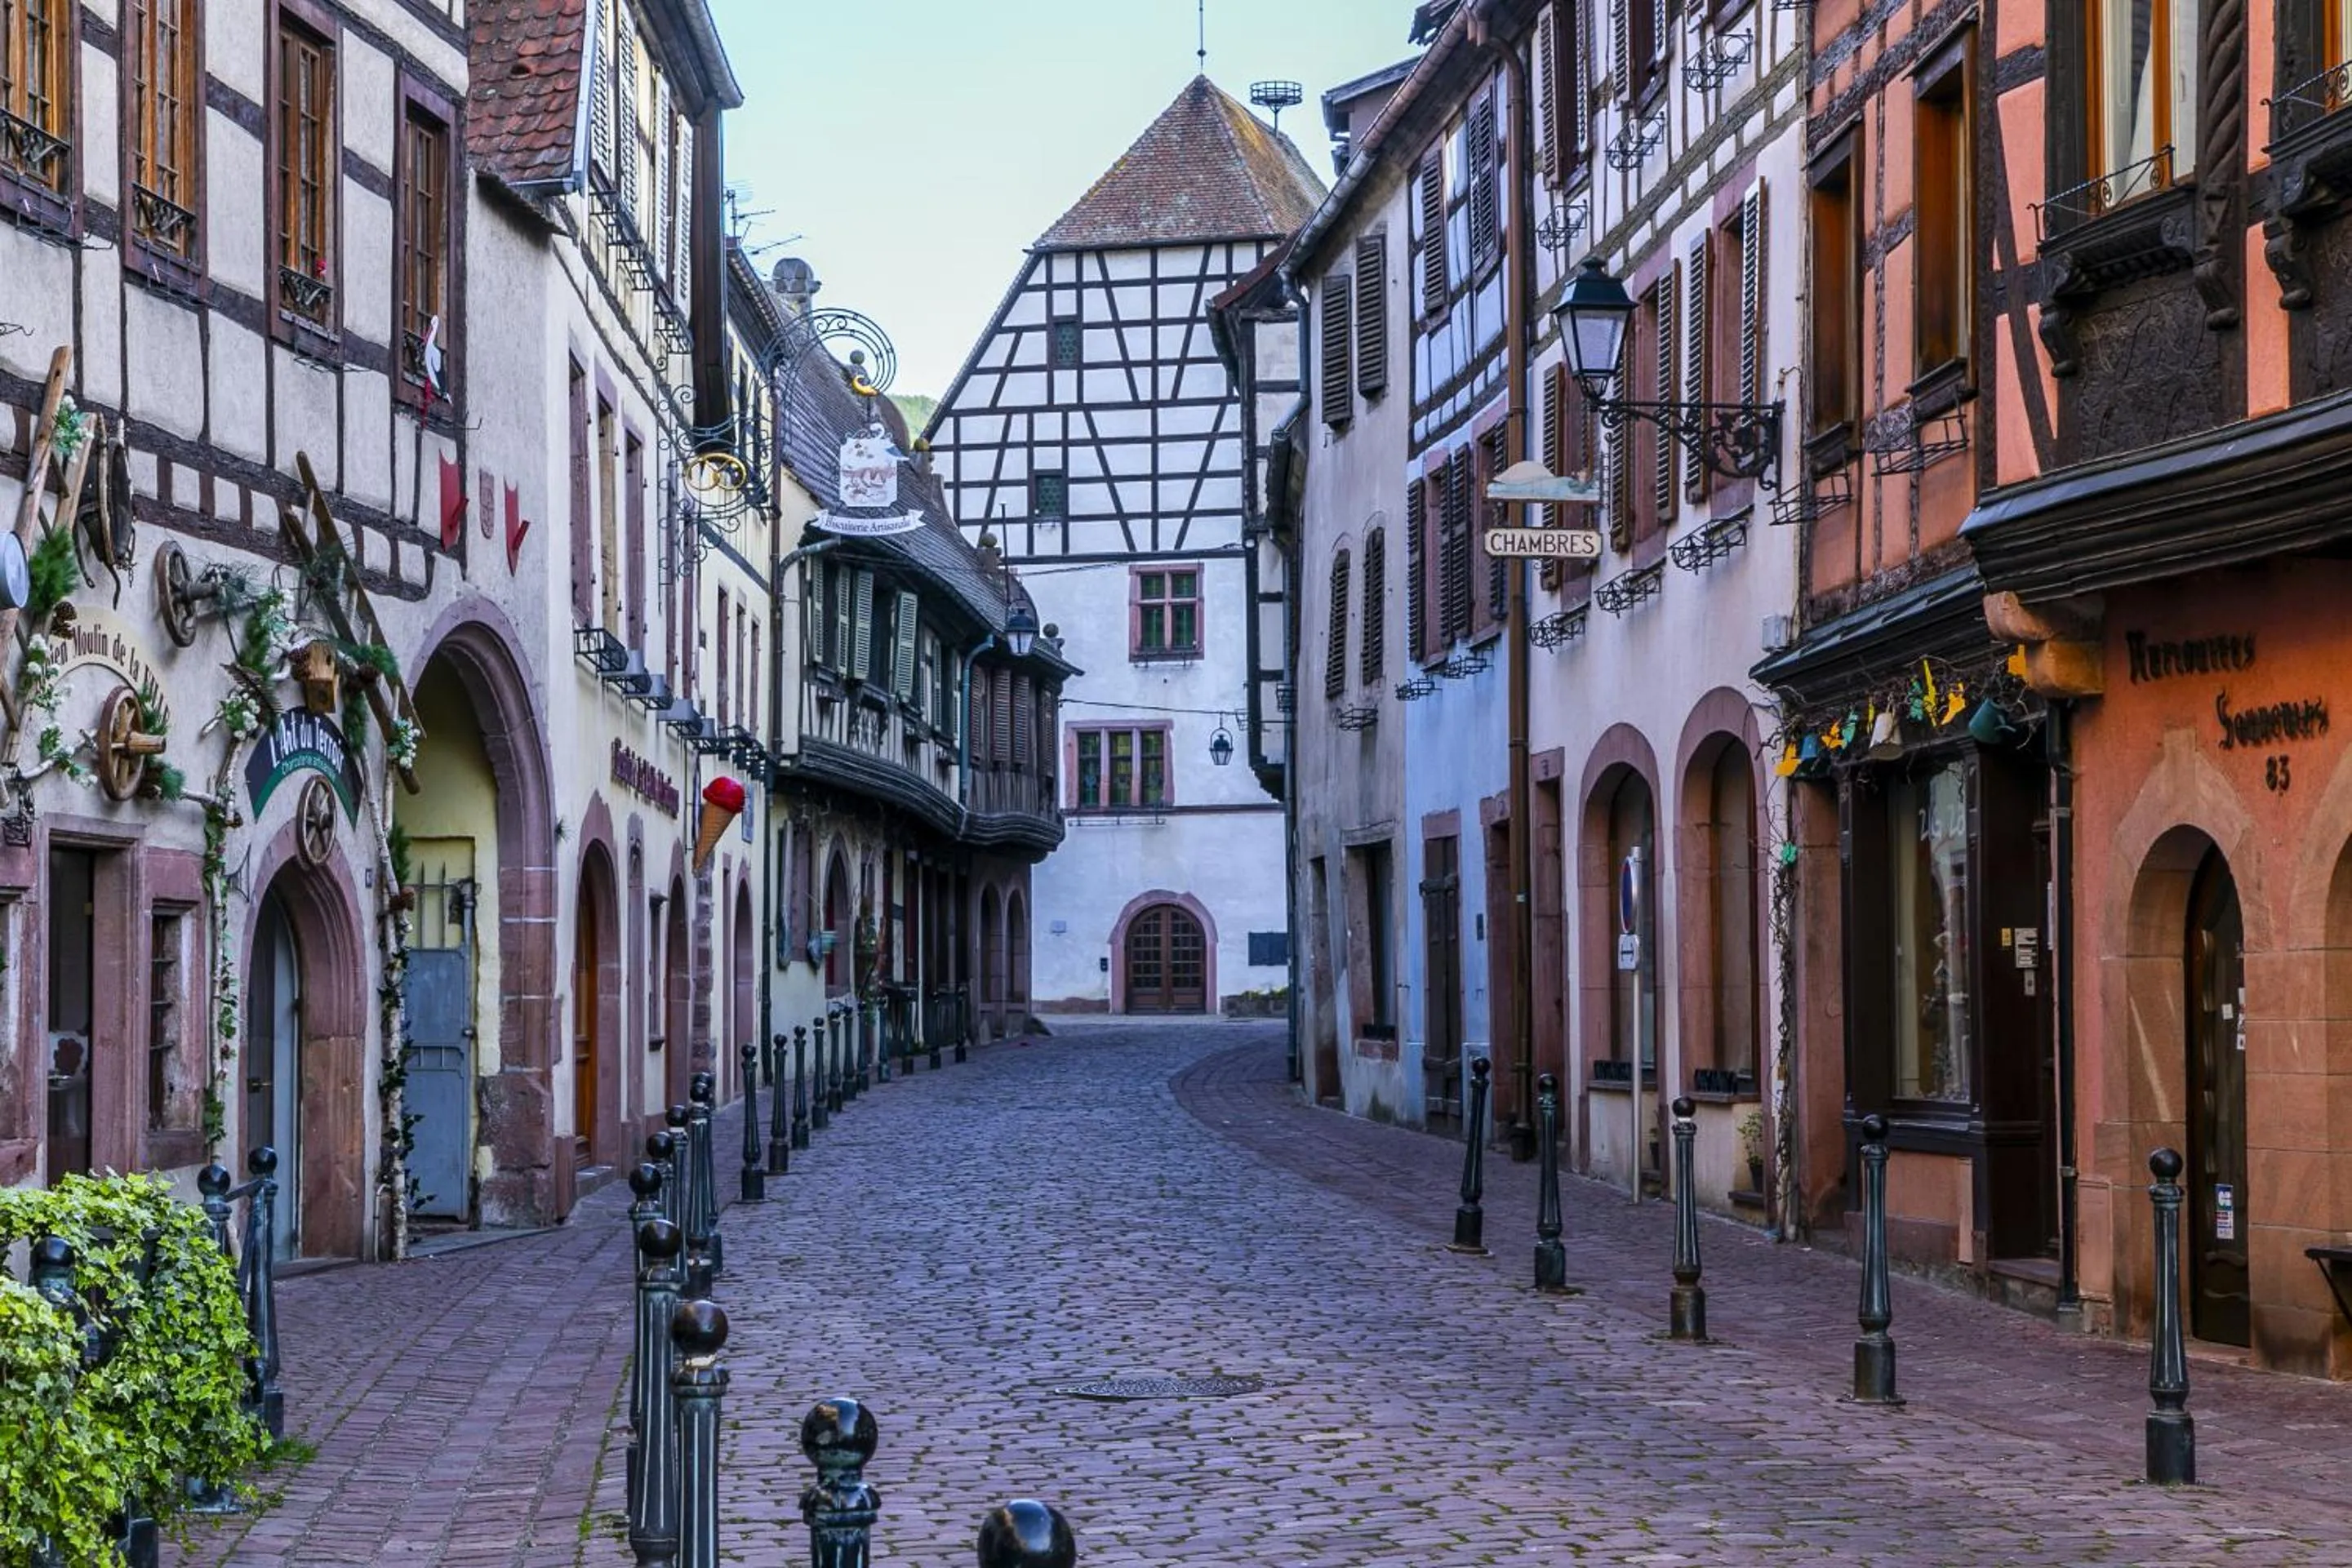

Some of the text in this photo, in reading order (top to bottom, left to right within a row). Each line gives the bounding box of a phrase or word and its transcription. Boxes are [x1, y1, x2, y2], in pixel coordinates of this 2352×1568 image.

[1491, 532, 1594, 554] CHAMBRES
[73, 624, 108, 656] Moulin
[113, 633, 126, 667] de
[129, 646, 140, 682] la
[300, 714, 313, 748] du
[315, 717, 344, 775] Terroir
